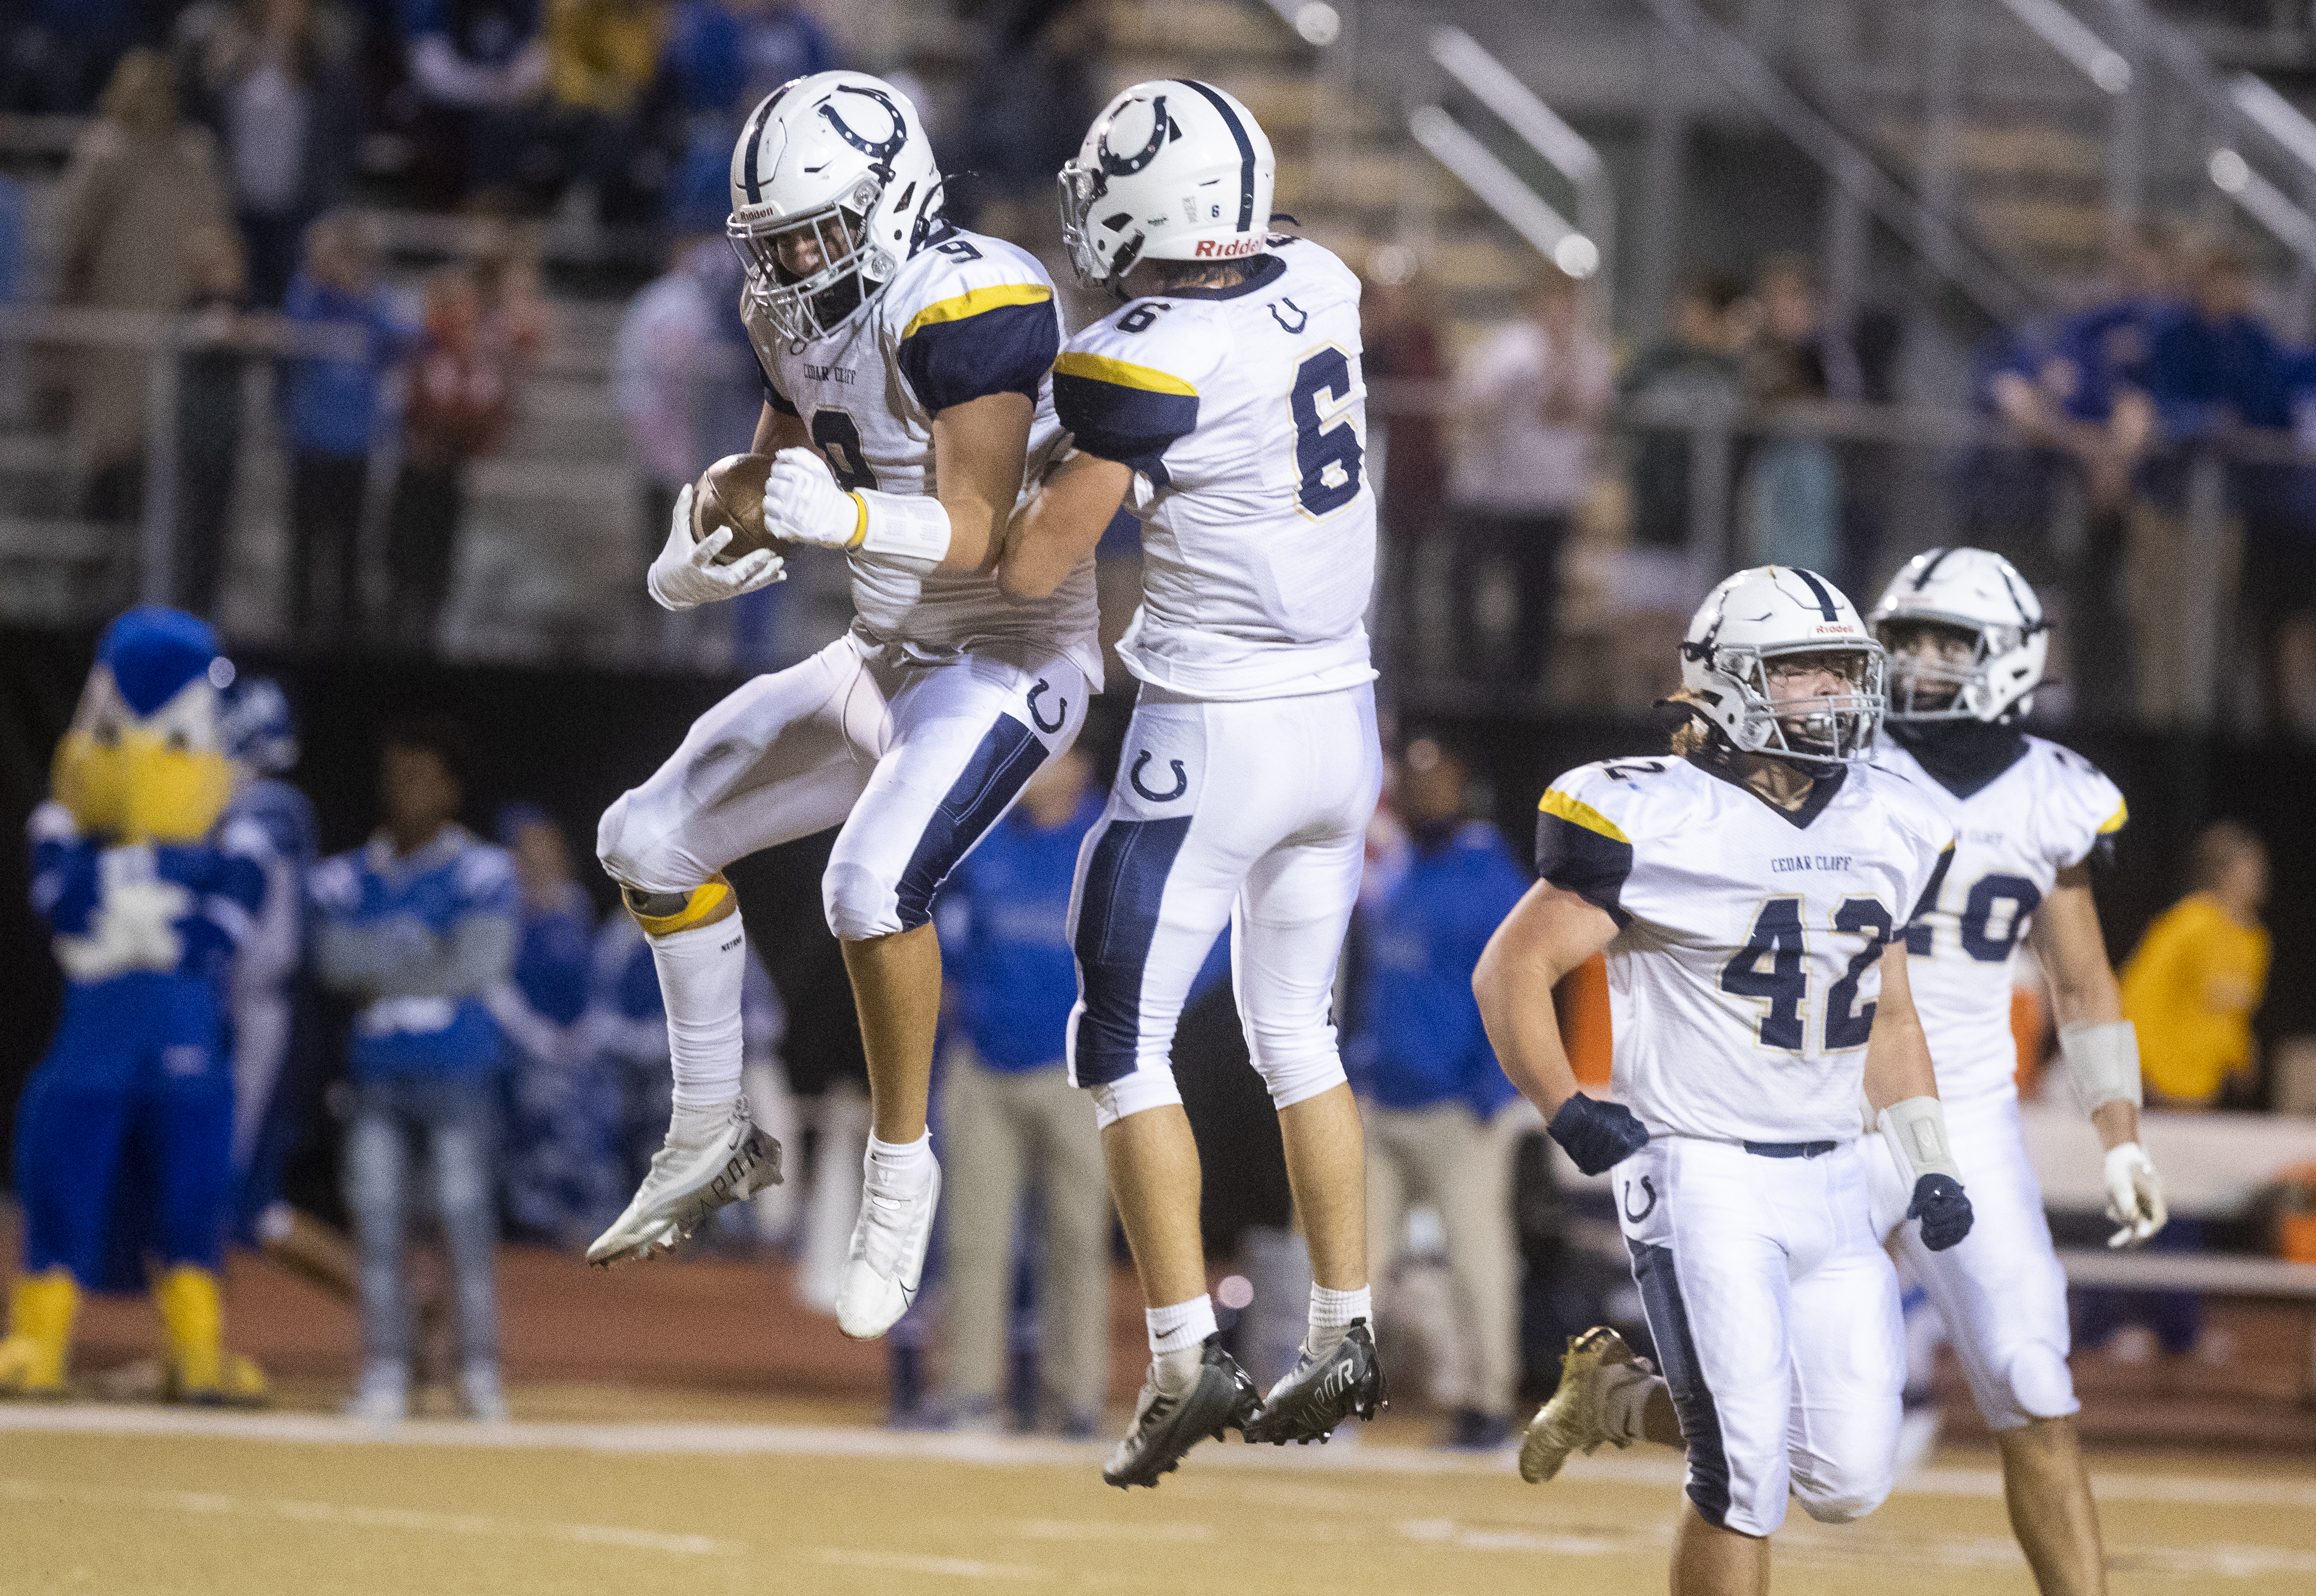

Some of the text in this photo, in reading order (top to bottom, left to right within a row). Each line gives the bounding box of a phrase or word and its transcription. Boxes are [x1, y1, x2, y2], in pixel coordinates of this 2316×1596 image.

[740, 207, 774, 220] Riddell
[935, 240, 984, 264] 9
[1115, 302, 1173, 335] 6
[804, 363, 856, 385] CEDAR CLIFF
[1286, 340, 1365, 523] 6
[1816, 625, 1854, 634] Riddell
[1771, 856, 1852, 873] CEDAR CLIFF
[1717, 894, 1893, 1054] 42
